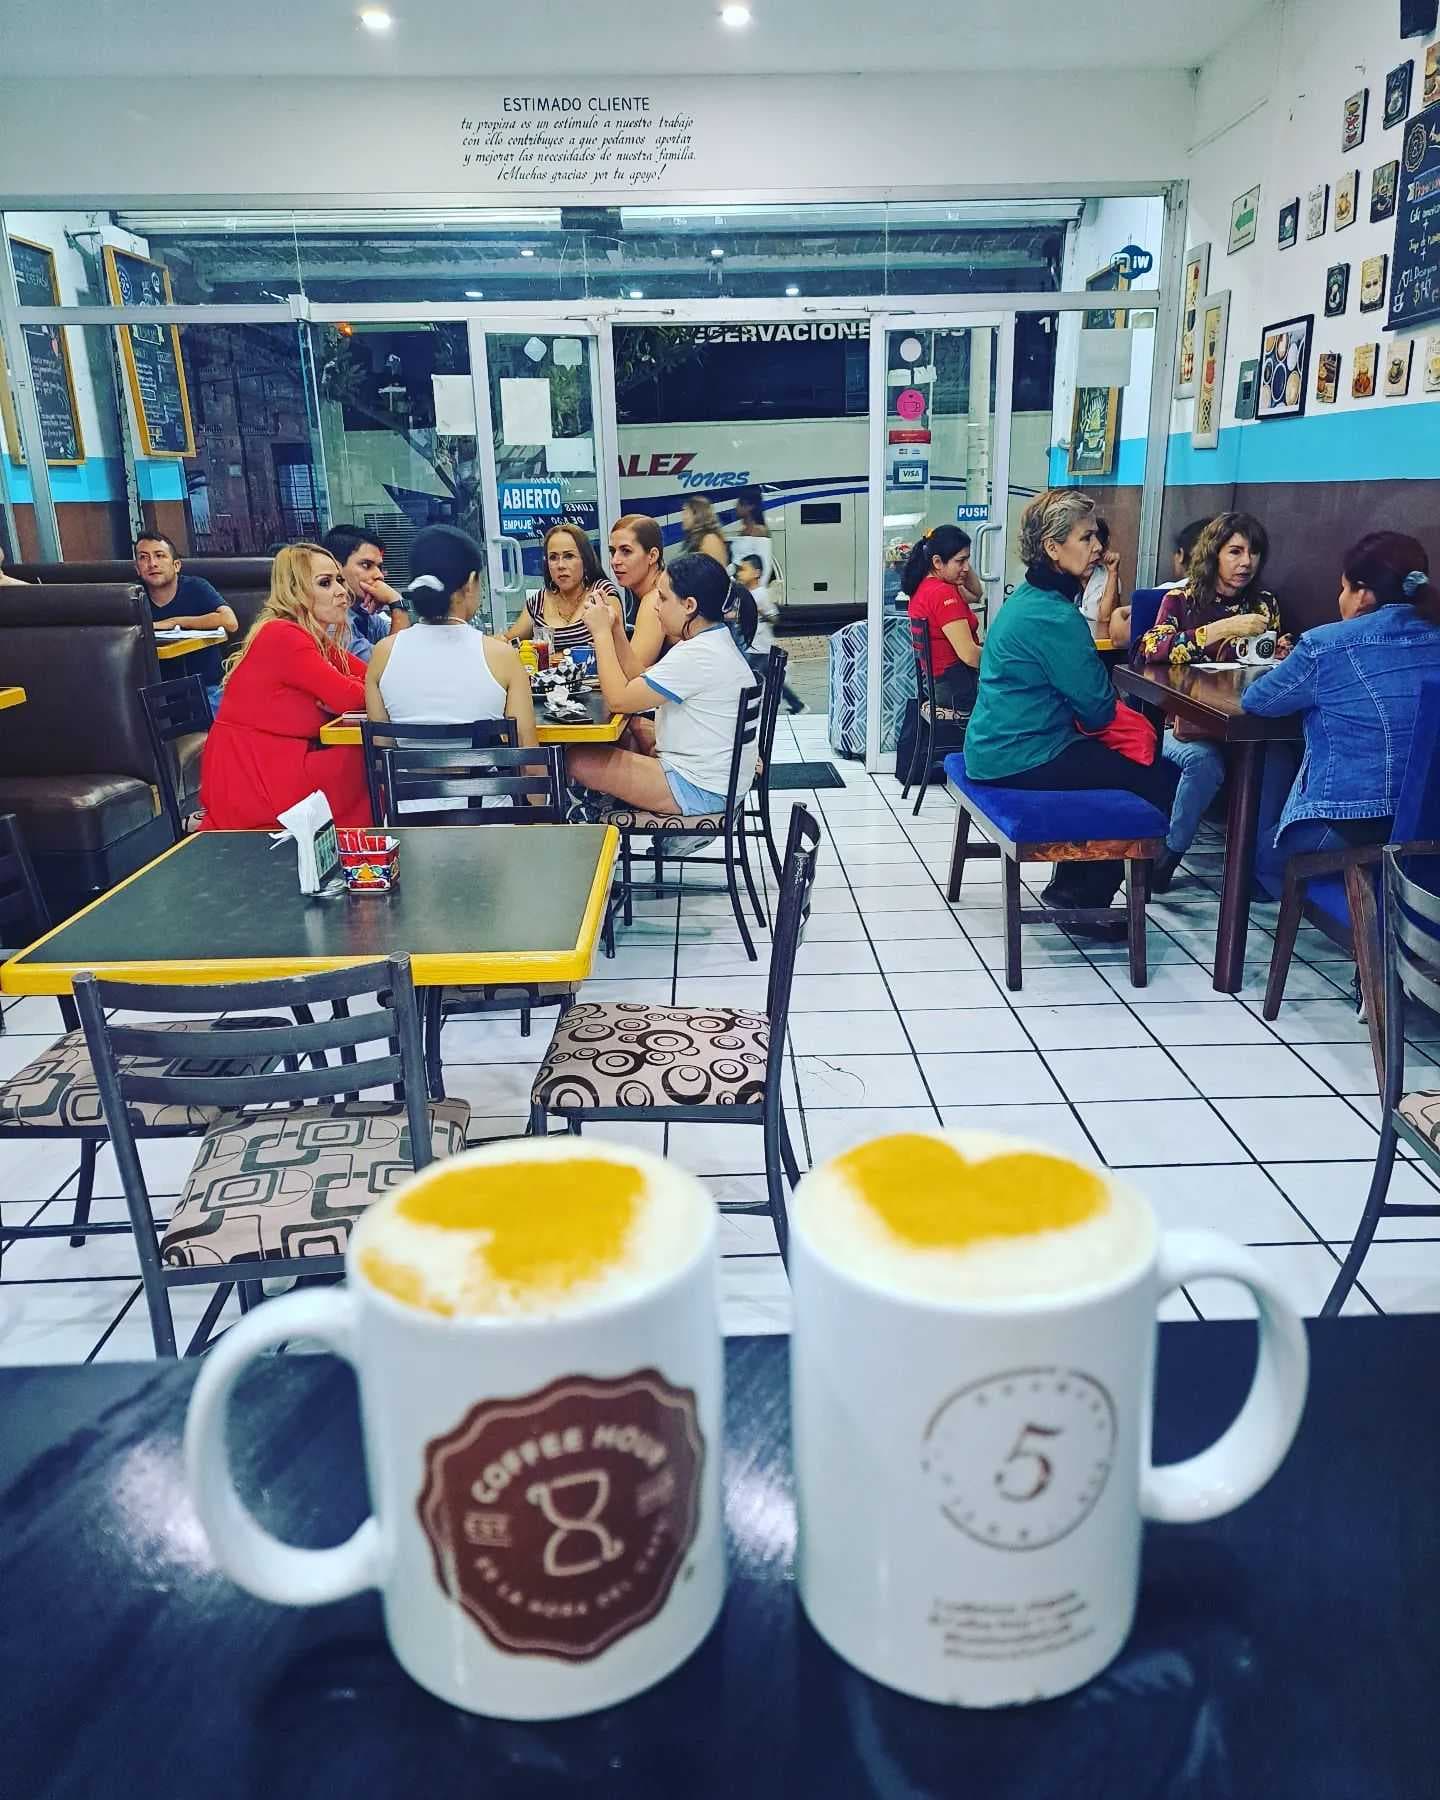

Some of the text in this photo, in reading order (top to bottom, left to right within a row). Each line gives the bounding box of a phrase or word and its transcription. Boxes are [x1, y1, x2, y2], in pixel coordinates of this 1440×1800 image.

[503, 96, 650, 112] ESTIMADO CLIENTE
[461, 118, 473, 130] tu
[476, 118, 516, 133] propina
[520, 120, 532, 129] es
[536, 120, 549, 129] un
[603, 120, 612, 128] a
[615, 115, 652, 129] nuestro
[659, 112, 694, 134] trabajo
[462, 129, 692, 149] con ello contribuyes a que podamos aportar
[462, 154, 471, 167] y
[475, 149, 515, 166] mejorar
[518, 147, 534, 161] las
[537, 147, 596, 161] necesidades
[599, 147, 612, 161] de
[616, 150, 653, 161] nuestra
[549, 168, 588, 184] gracias
[590, 170, 608, 185] por
[613, 167, 625, 180] tu
[629, 163, 667, 186] apoyo!
[694, 322, 871, 344] ESERVACIONE
[677, 470, 750, 488] TOURS
[902, 470, 920, 478] VISA
[503, 488, 561, 510] ABIERTO
[958, 507, 988, 518] PUSH
[503, 519, 532, 531] EMPUJE
[993, 1422, 1066, 1503] 5
